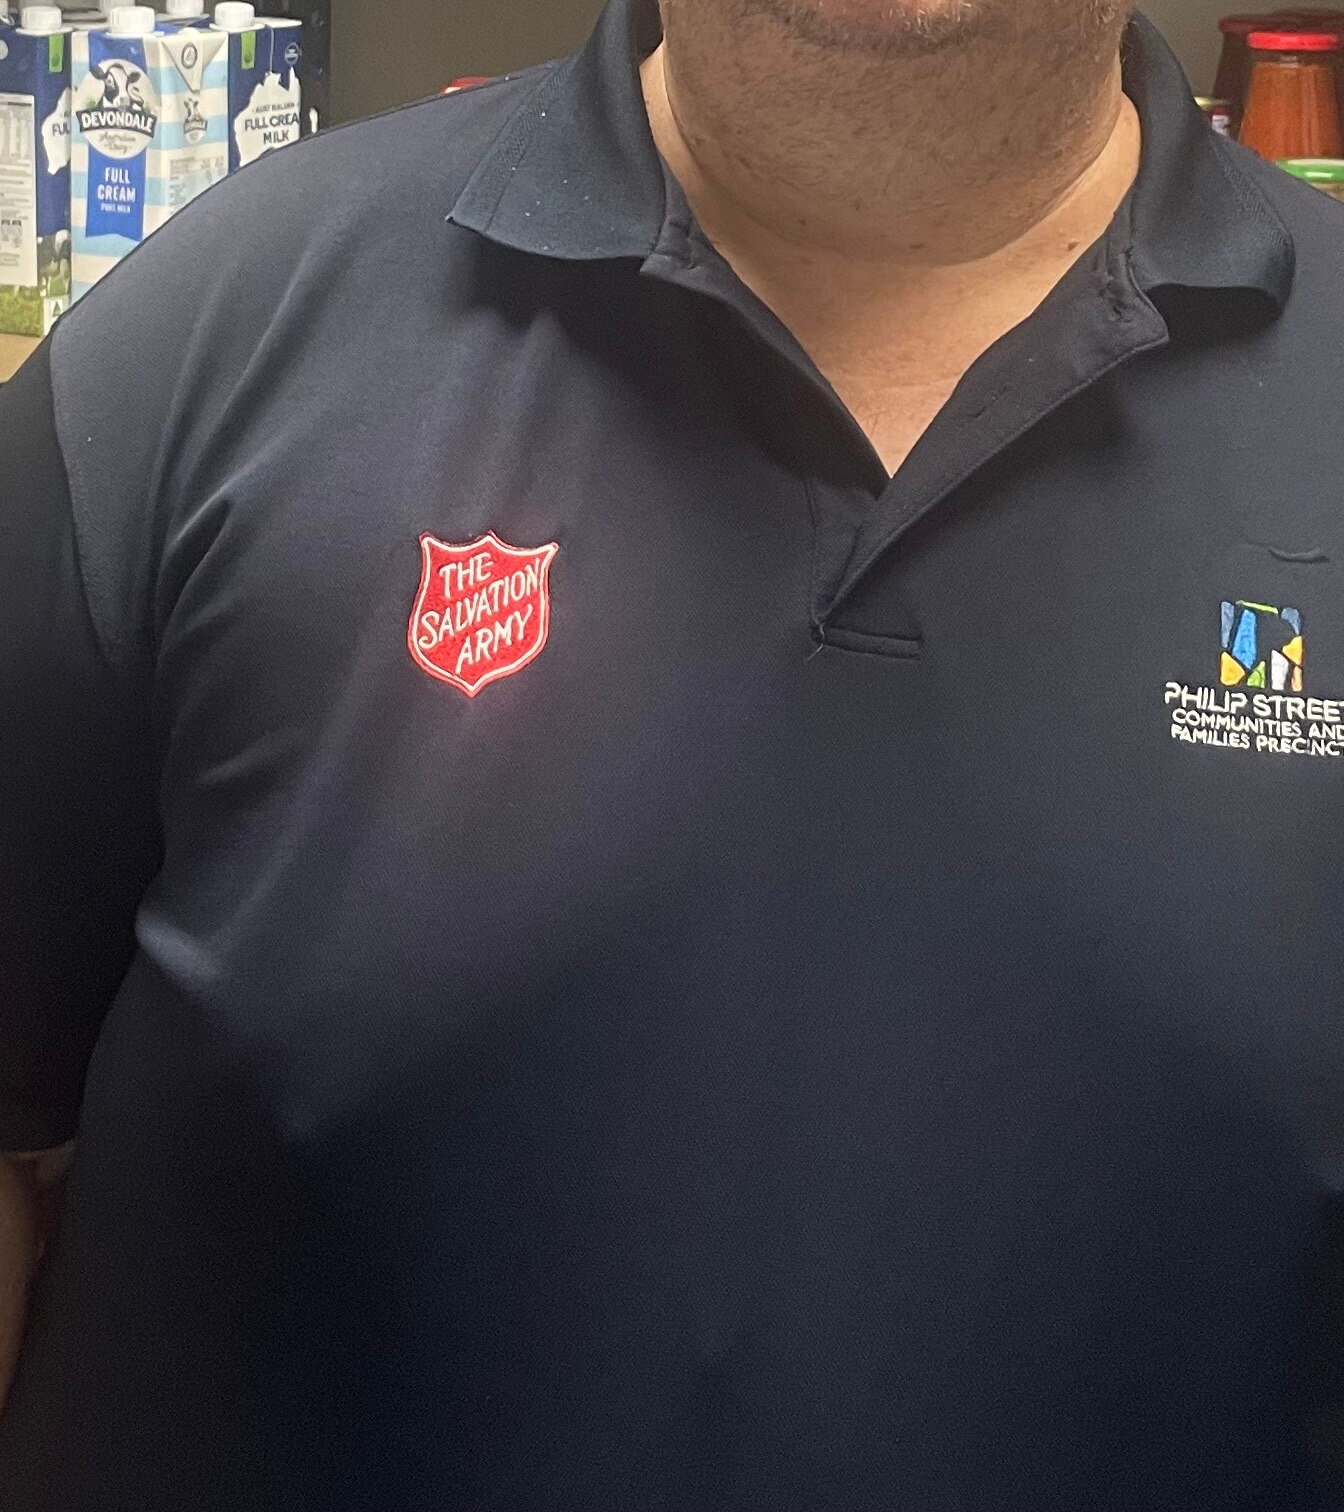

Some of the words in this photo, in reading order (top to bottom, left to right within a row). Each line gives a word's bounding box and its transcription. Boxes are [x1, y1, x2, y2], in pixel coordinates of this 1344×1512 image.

[81, 110, 155, 134] DEVONDALE
[244, 115, 268, 132] FULL
[268, 110, 299, 128] CREA
[263, 129, 290, 145] MILK
[105, 167, 131, 185] FULL
[97, 184, 137, 203] CREAM
[439, 552, 494, 599] THE
[418, 557, 541, 651] SALVATION
[455, 603, 533, 675] ARMY
[1164, 681, 1248, 716] PHILIP
[1170, 722, 1251, 751] FAMILIES
[1171, 707, 1301, 738] COMMUNITIES
